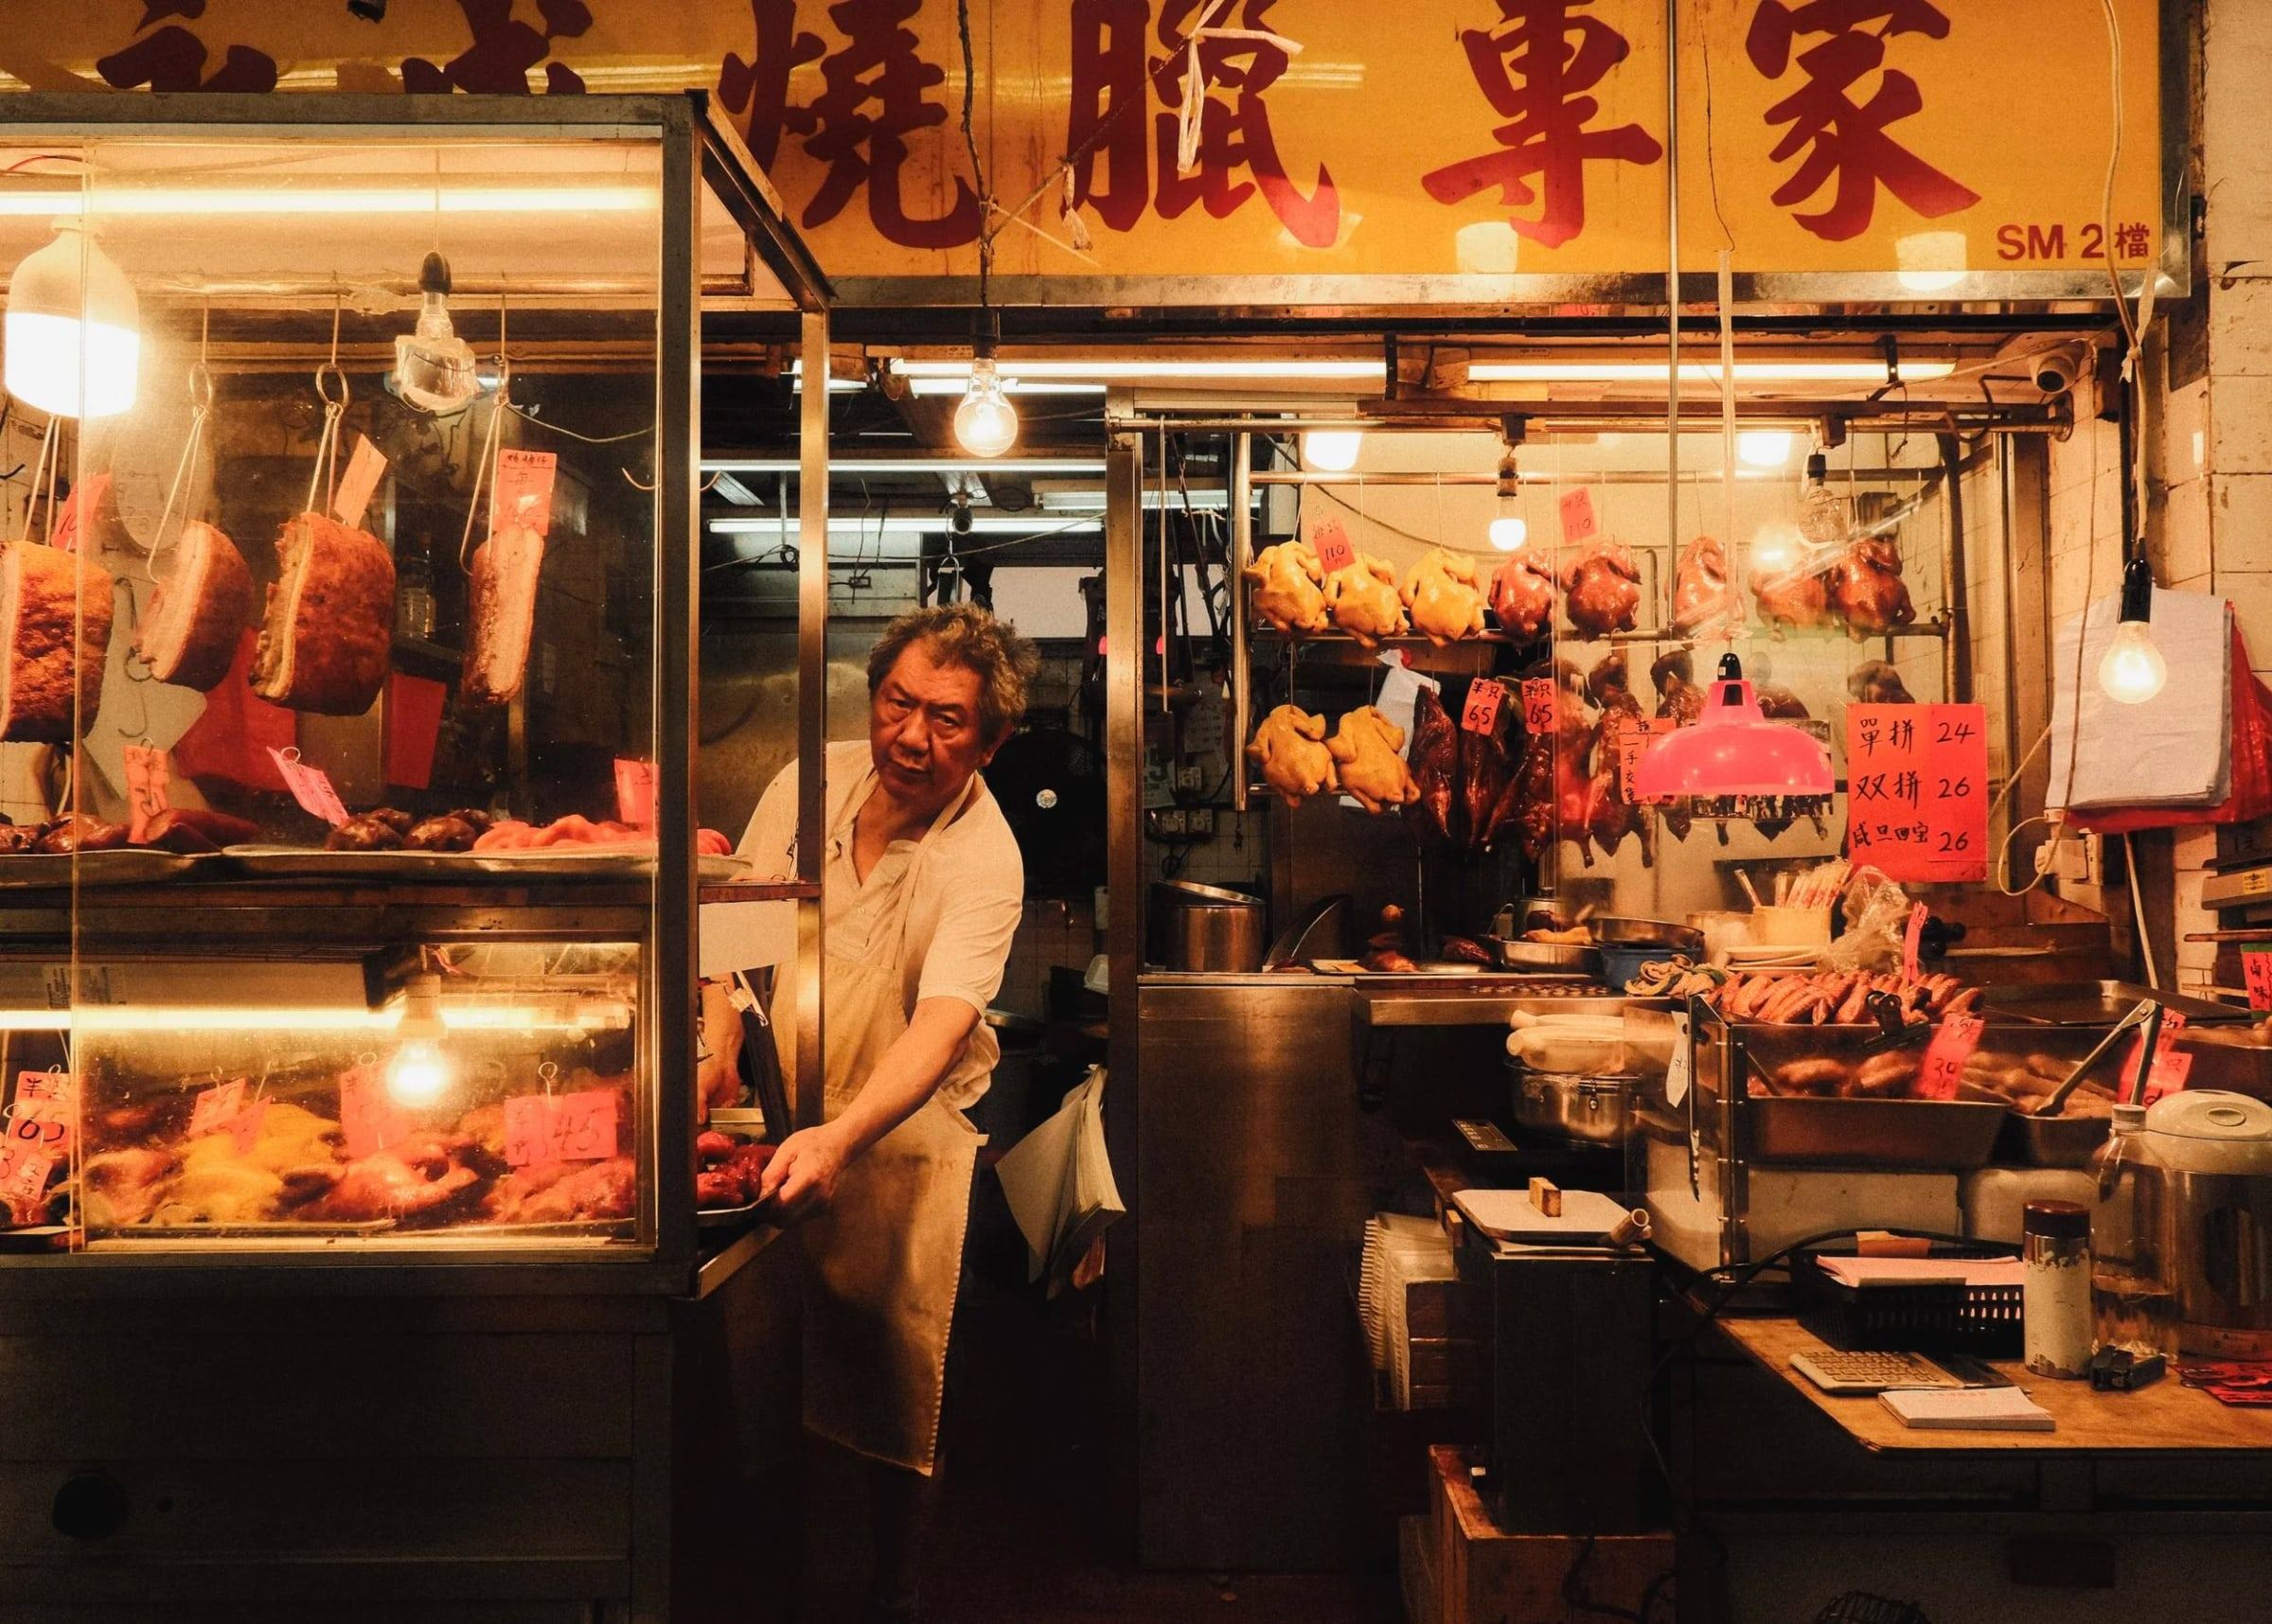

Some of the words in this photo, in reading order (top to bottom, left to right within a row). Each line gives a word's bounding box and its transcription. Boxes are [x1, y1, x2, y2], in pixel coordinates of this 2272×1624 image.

[1997, 223, 2064, 260] SM
[1324, 544, 1345, 561] 110
[1468, 704, 1492, 725] 65
[1530, 703, 1553, 725] 65
[1859, 717, 1916, 758] 單拼
[1936, 721, 1975, 744] 24
[1855, 770, 1923, 810] 双拼
[1937, 776, 1971, 799] 26
[1937, 830, 1969, 853] 26
